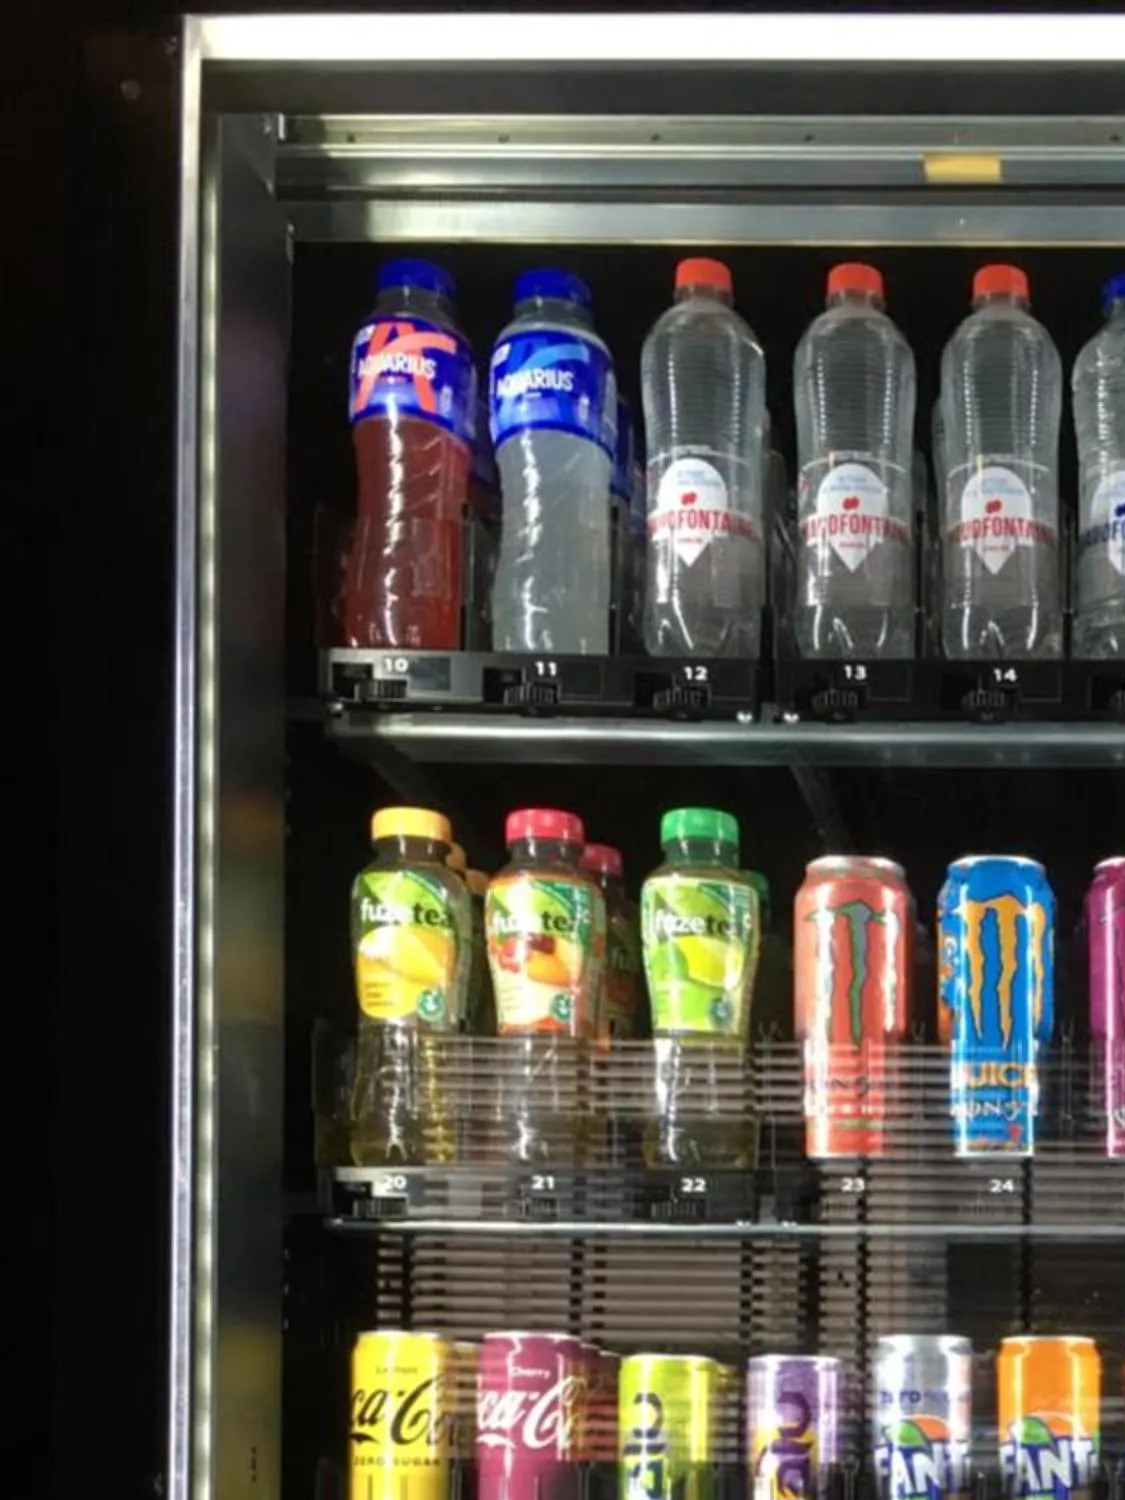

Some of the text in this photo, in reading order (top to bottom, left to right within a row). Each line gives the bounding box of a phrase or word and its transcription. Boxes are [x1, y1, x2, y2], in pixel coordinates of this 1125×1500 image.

[384, 657, 409, 672] 10
[536, 661, 557, 676] 11
[684, 666, 708, 681] 12
[844, 665, 867, 680] 13
[994, 668, 1017, 682] 14
[531, 1174, 555, 1190] 21
[681, 1177, 706, 1193] 22
[841, 1177, 865, 1192] 23
[990, 1179, 1015, 1193] 24
